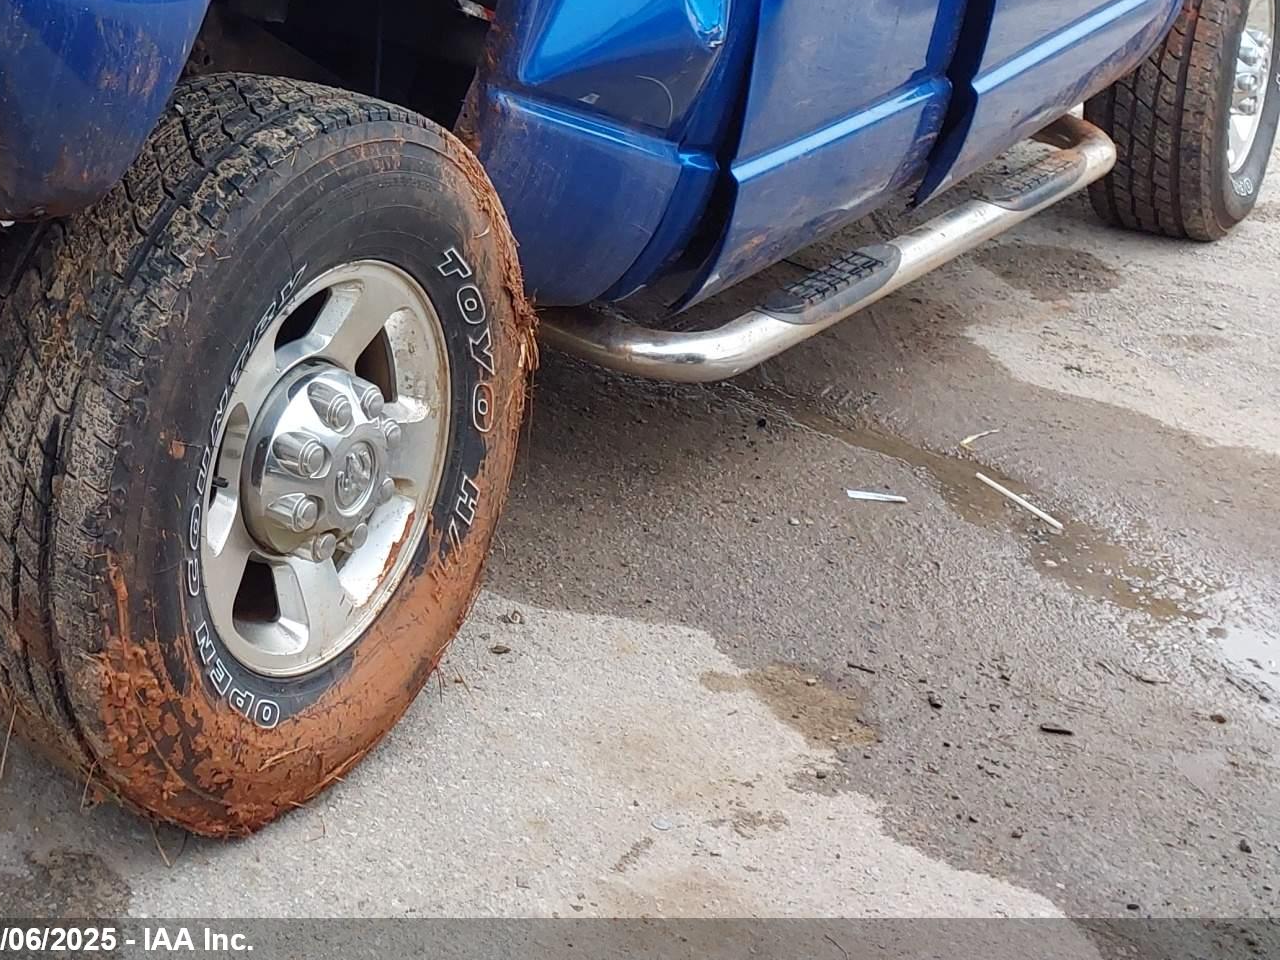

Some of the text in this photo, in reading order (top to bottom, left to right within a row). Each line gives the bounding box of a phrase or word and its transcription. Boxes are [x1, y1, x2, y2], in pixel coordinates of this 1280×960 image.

[186, 261, 309, 729] OPEN COUNTRY
[437, 247, 495, 432] TOYO
